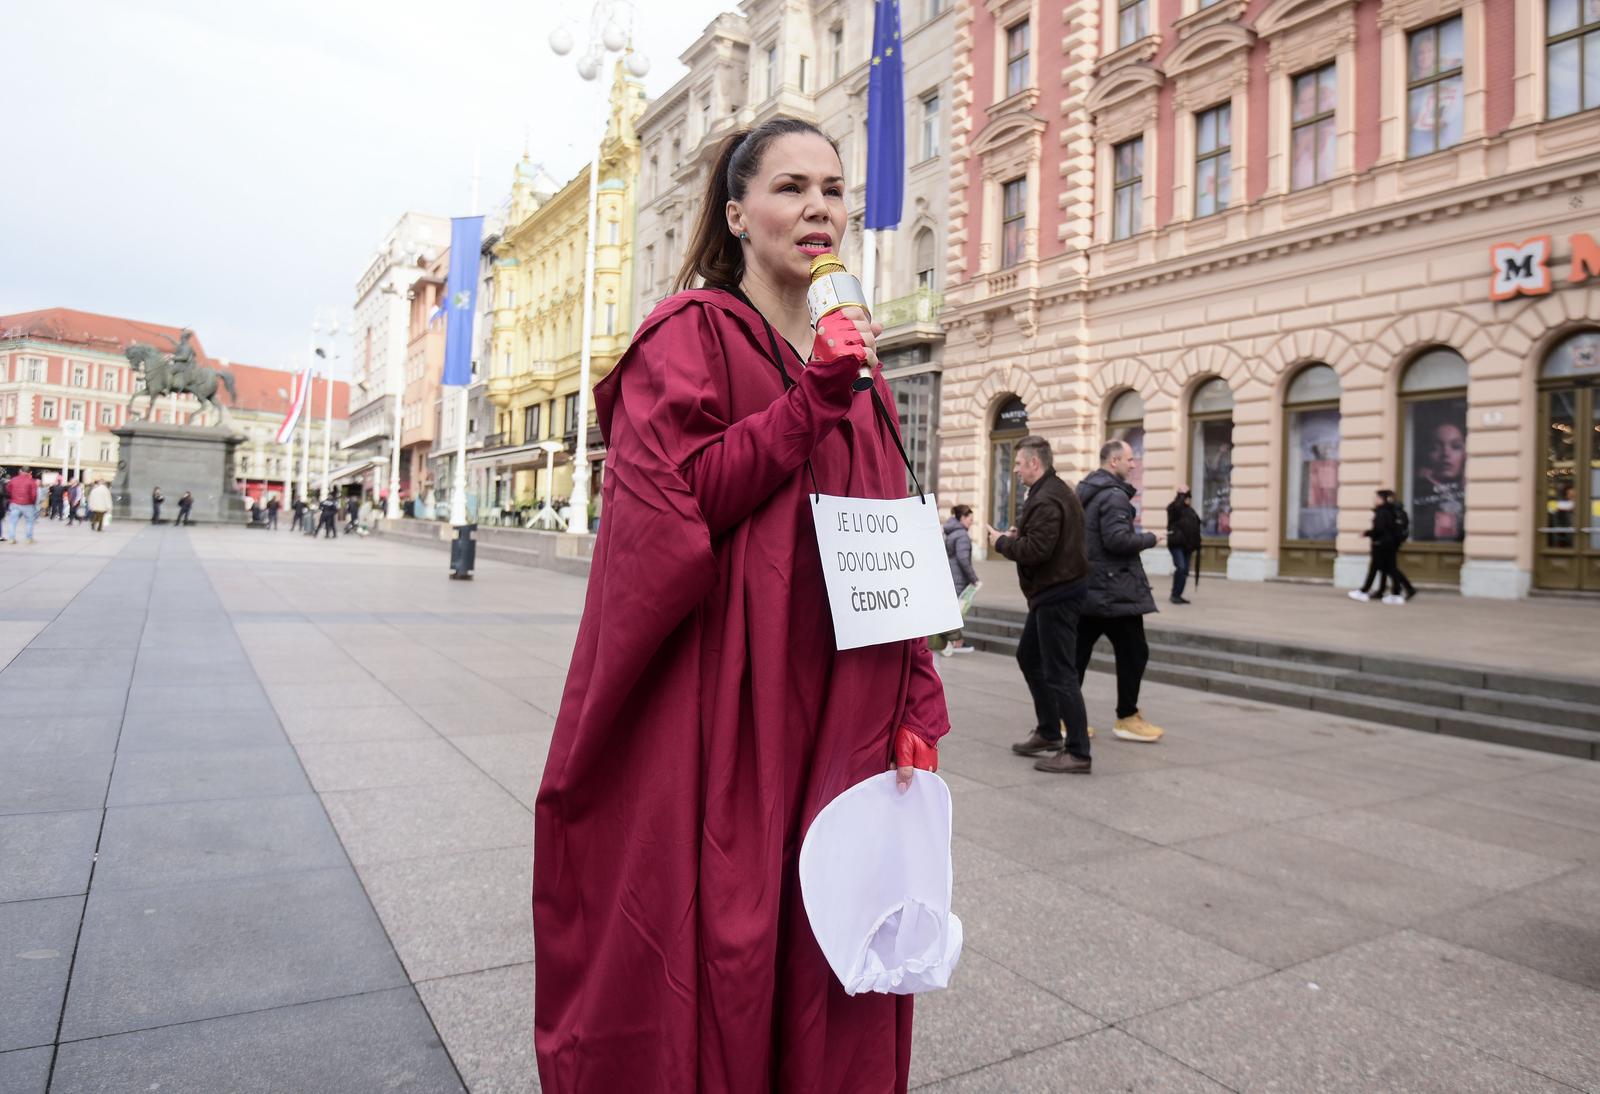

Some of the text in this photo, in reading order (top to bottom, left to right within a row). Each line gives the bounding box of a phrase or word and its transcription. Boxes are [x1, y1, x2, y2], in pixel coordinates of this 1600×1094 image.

[1504, 254, 1534, 282] M
[837, 512, 898, 533] JE LI OVO
[837, 550, 915, 572] DOVOLJNO
[851, 586, 909, 612] ČEDNO?
